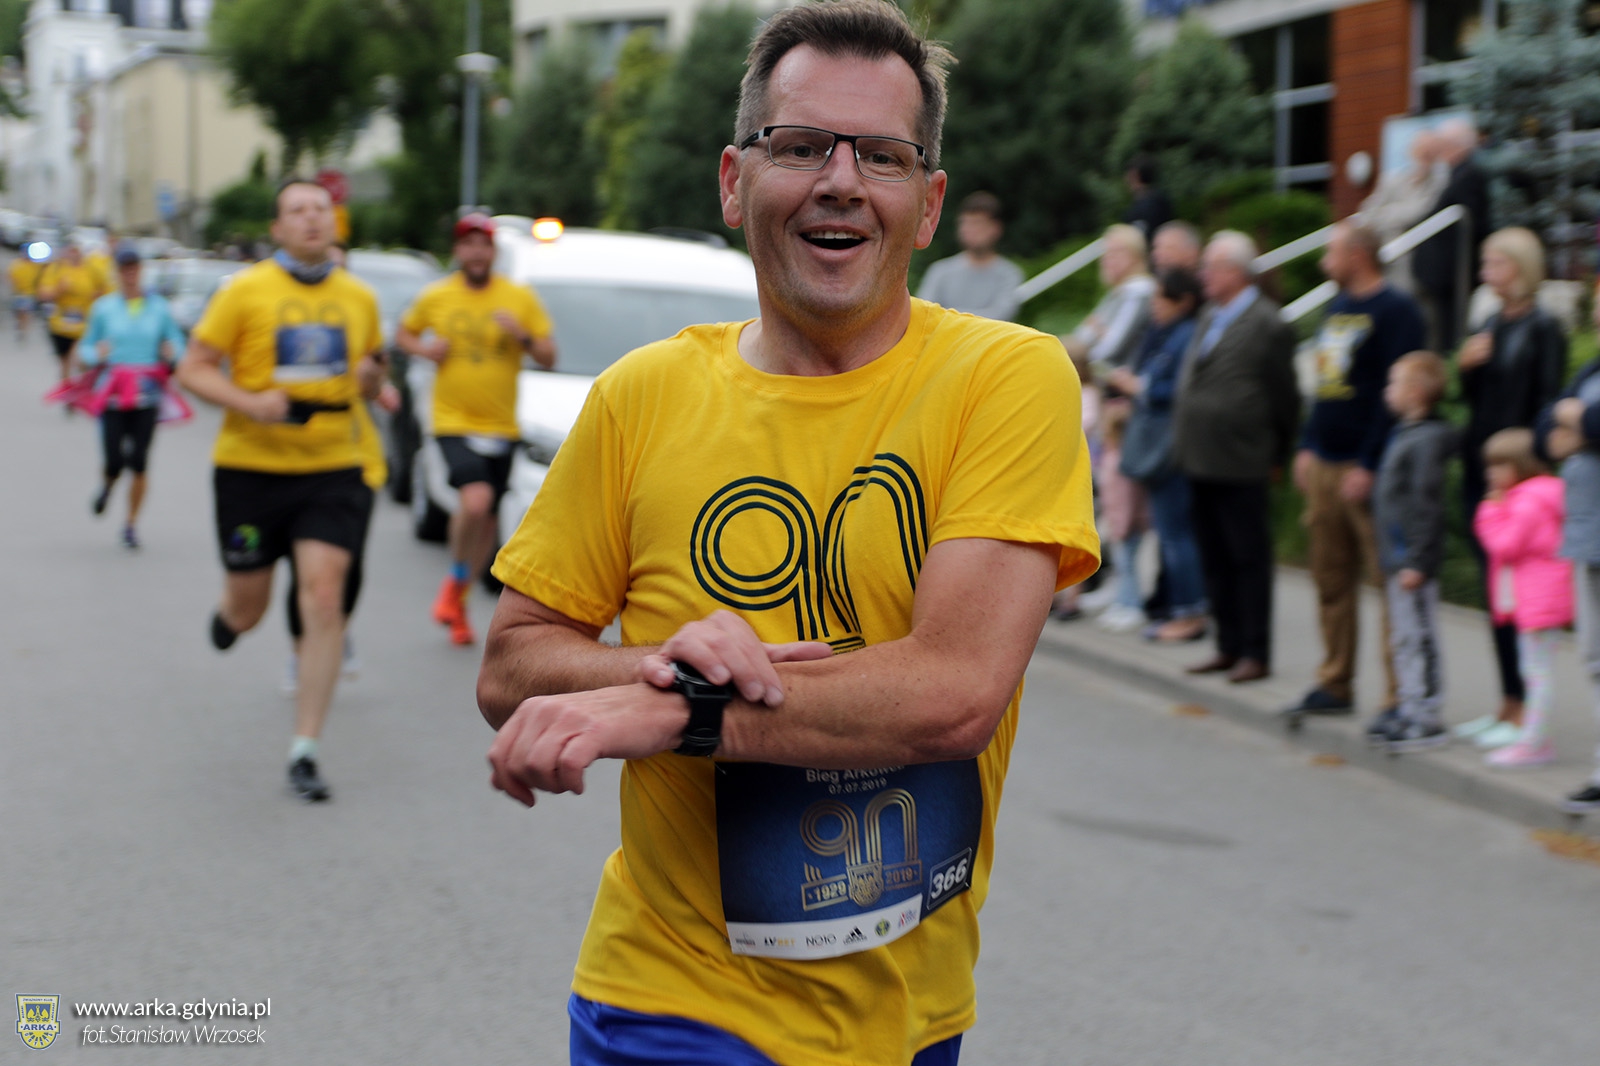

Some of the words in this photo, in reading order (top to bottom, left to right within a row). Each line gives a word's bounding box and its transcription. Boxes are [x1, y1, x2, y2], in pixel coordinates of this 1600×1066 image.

[806, 768, 839, 784] Bieg
[843, 765, 904, 780] Arkow
[828, 778, 887, 795] 07.07.2019
[814, 881, 847, 902] 1929
[885, 867, 913, 884] 2019
[931, 858, 968, 899] 366
